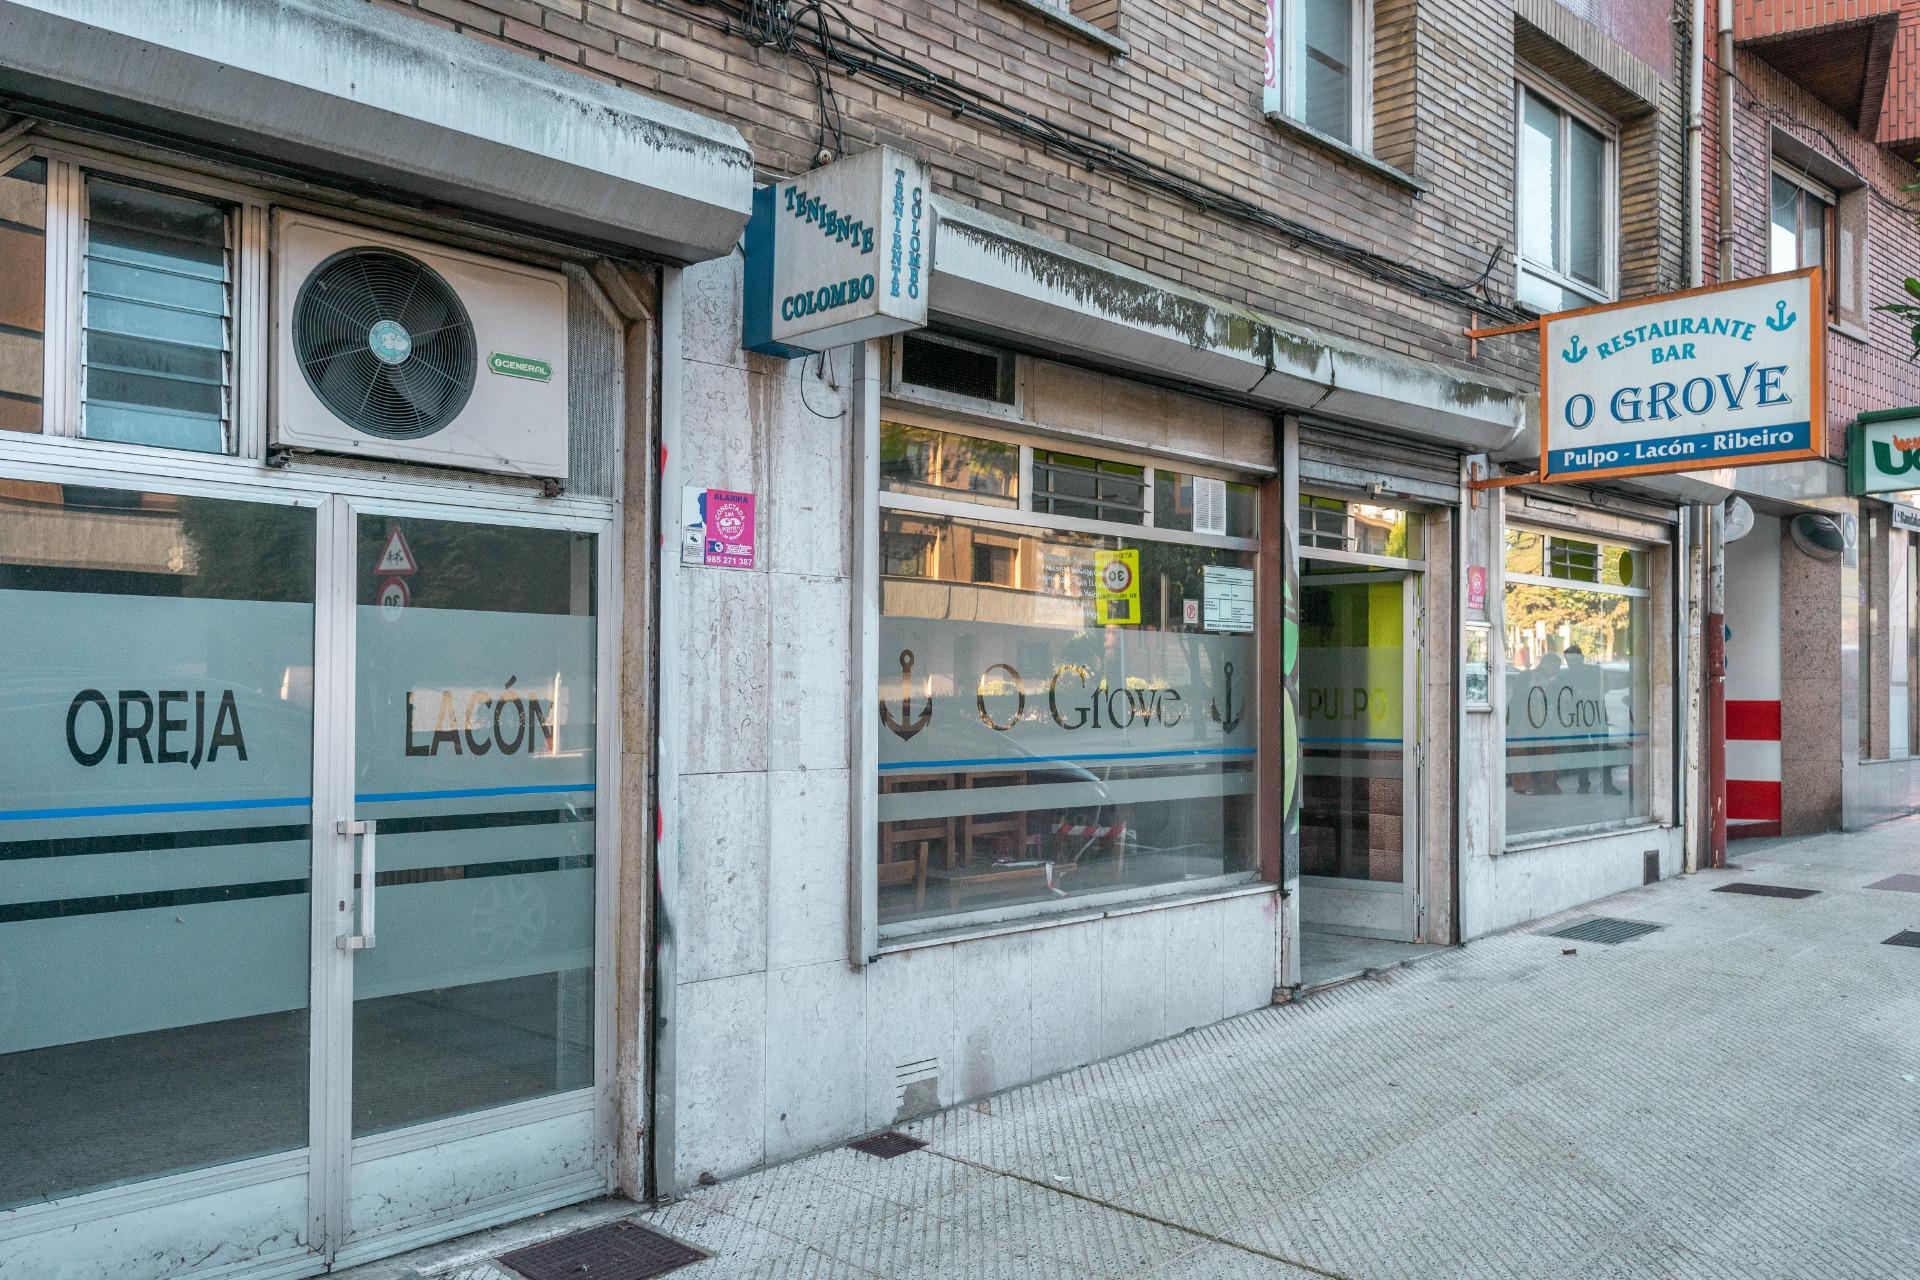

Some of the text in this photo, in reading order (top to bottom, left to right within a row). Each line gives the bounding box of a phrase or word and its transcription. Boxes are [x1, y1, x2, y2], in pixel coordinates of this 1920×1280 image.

[784, 185, 874, 255] TENIENTE
[890, 168, 905, 298] TENIENTE
[907, 187, 922, 300] COLOMBO
[781, 274, 875, 321] COLOMBO
[1596, 317, 1756, 360] RESTAURANTE
[1651, 342, 1696, 364] BAR
[502, 360, 548, 375] GENERAL
[1564, 361, 1792, 429] O GROVE
[1563, 449, 1619, 467] Pulpo
[1635, 439, 1695, 460] Lacón
[1714, 429, 1794, 450] Ribeiro
[714, 494, 748, 503] ALARMA
[706, 555, 753, 566] 985 271 387
[405, 675, 555, 758] LACÓN
[976, 663, 1182, 731] O Grove
[1527, 685, 1548, 729] O
[66, 688, 249, 770] OREJA
